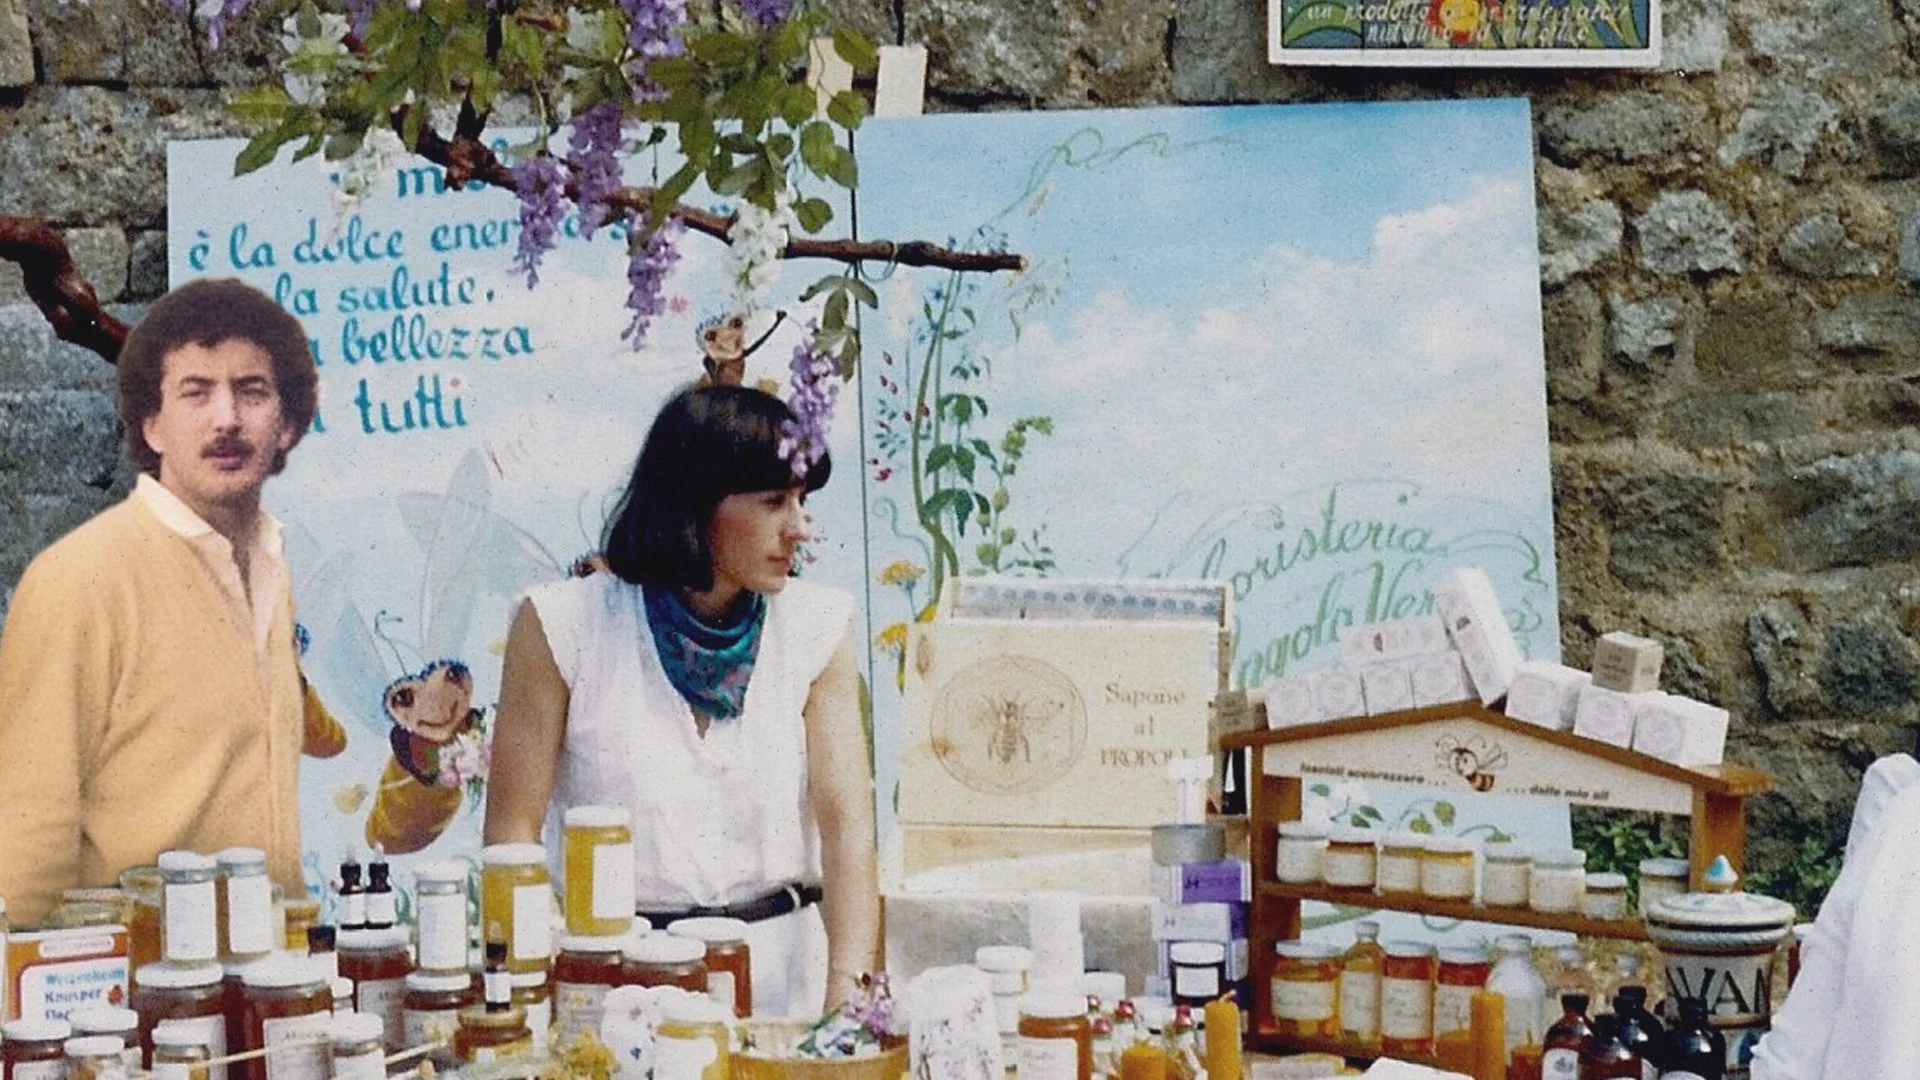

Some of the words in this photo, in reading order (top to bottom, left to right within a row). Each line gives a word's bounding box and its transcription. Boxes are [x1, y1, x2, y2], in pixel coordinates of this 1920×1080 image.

[189, 228, 210, 271] è
[229, 221, 276, 270] la
[293, 213, 404, 264] dolce
[275, 271, 318, 315] la
[341, 312, 535, 365] bellezza
[354, 372, 468, 434] tutti
[1104, 682, 1186, 708] Sapone
[1133, 714, 1154, 736] al
